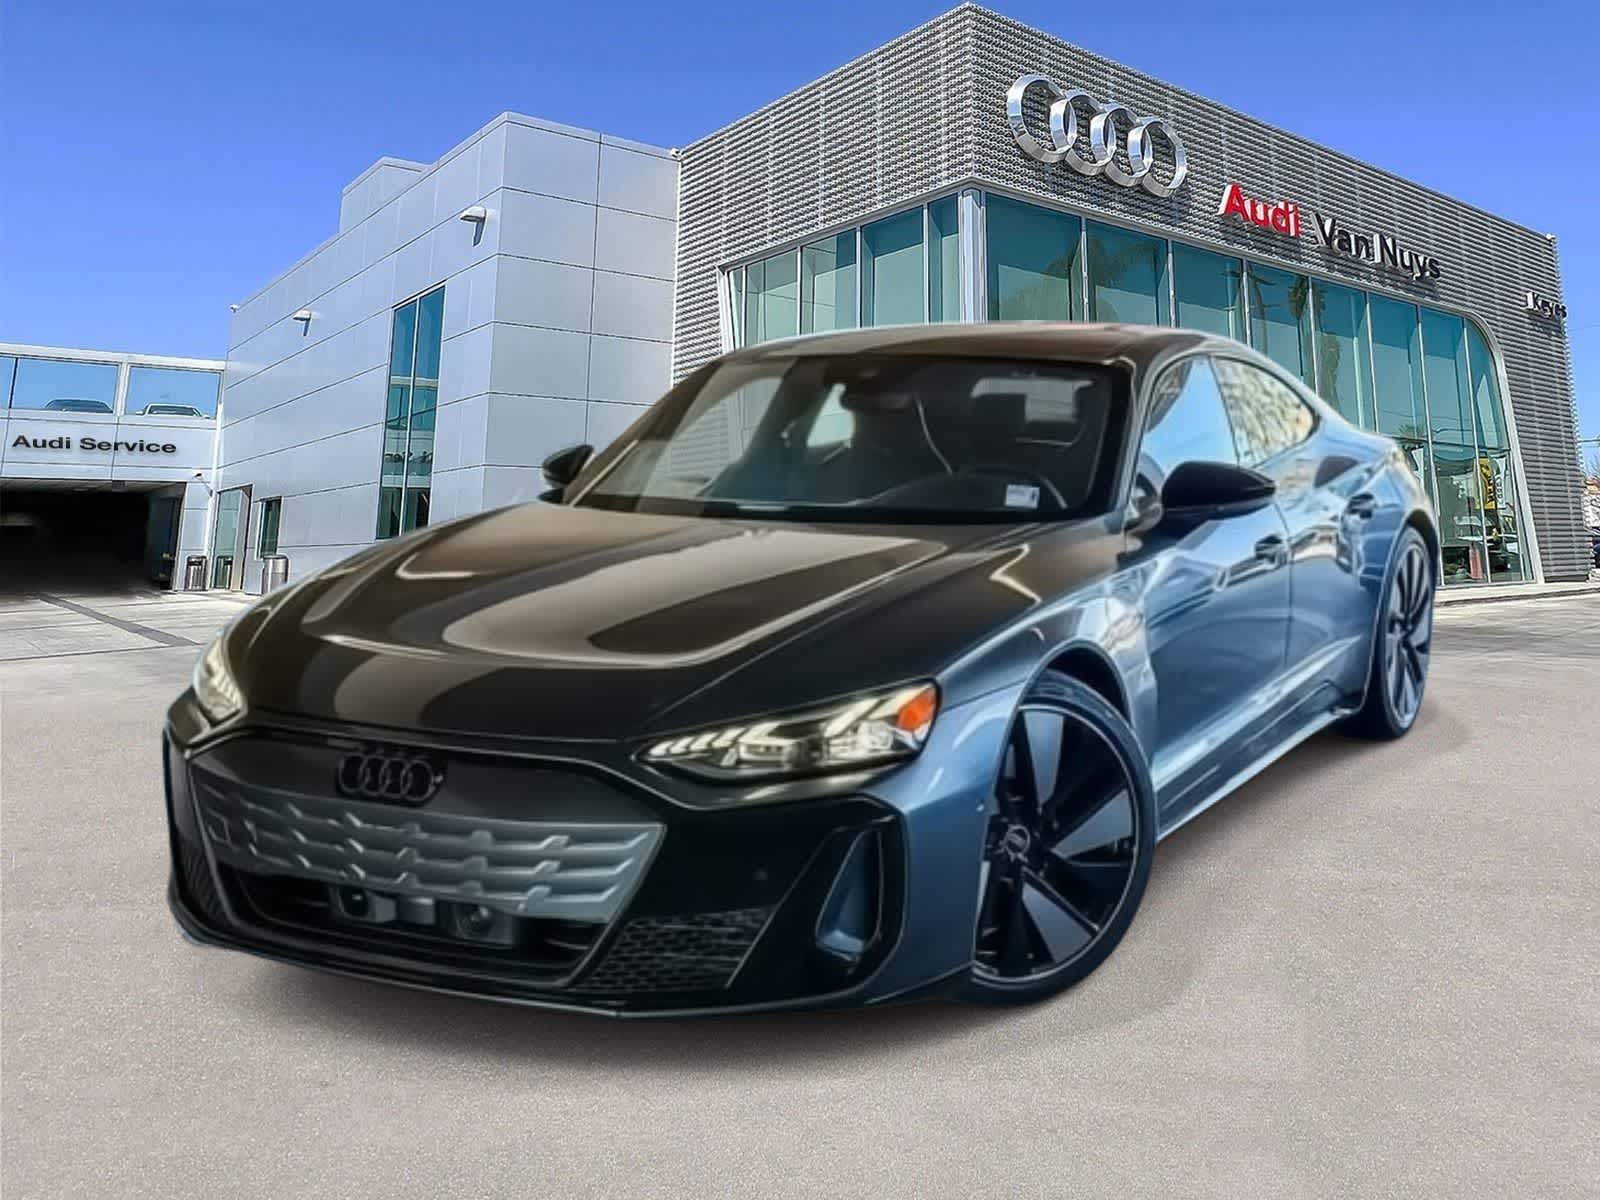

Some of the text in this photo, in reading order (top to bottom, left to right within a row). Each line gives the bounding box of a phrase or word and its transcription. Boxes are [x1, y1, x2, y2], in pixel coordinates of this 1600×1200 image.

[1218, 182, 1441, 281] Audi Van Nuys
[12, 435, 177, 453] Audi Service
